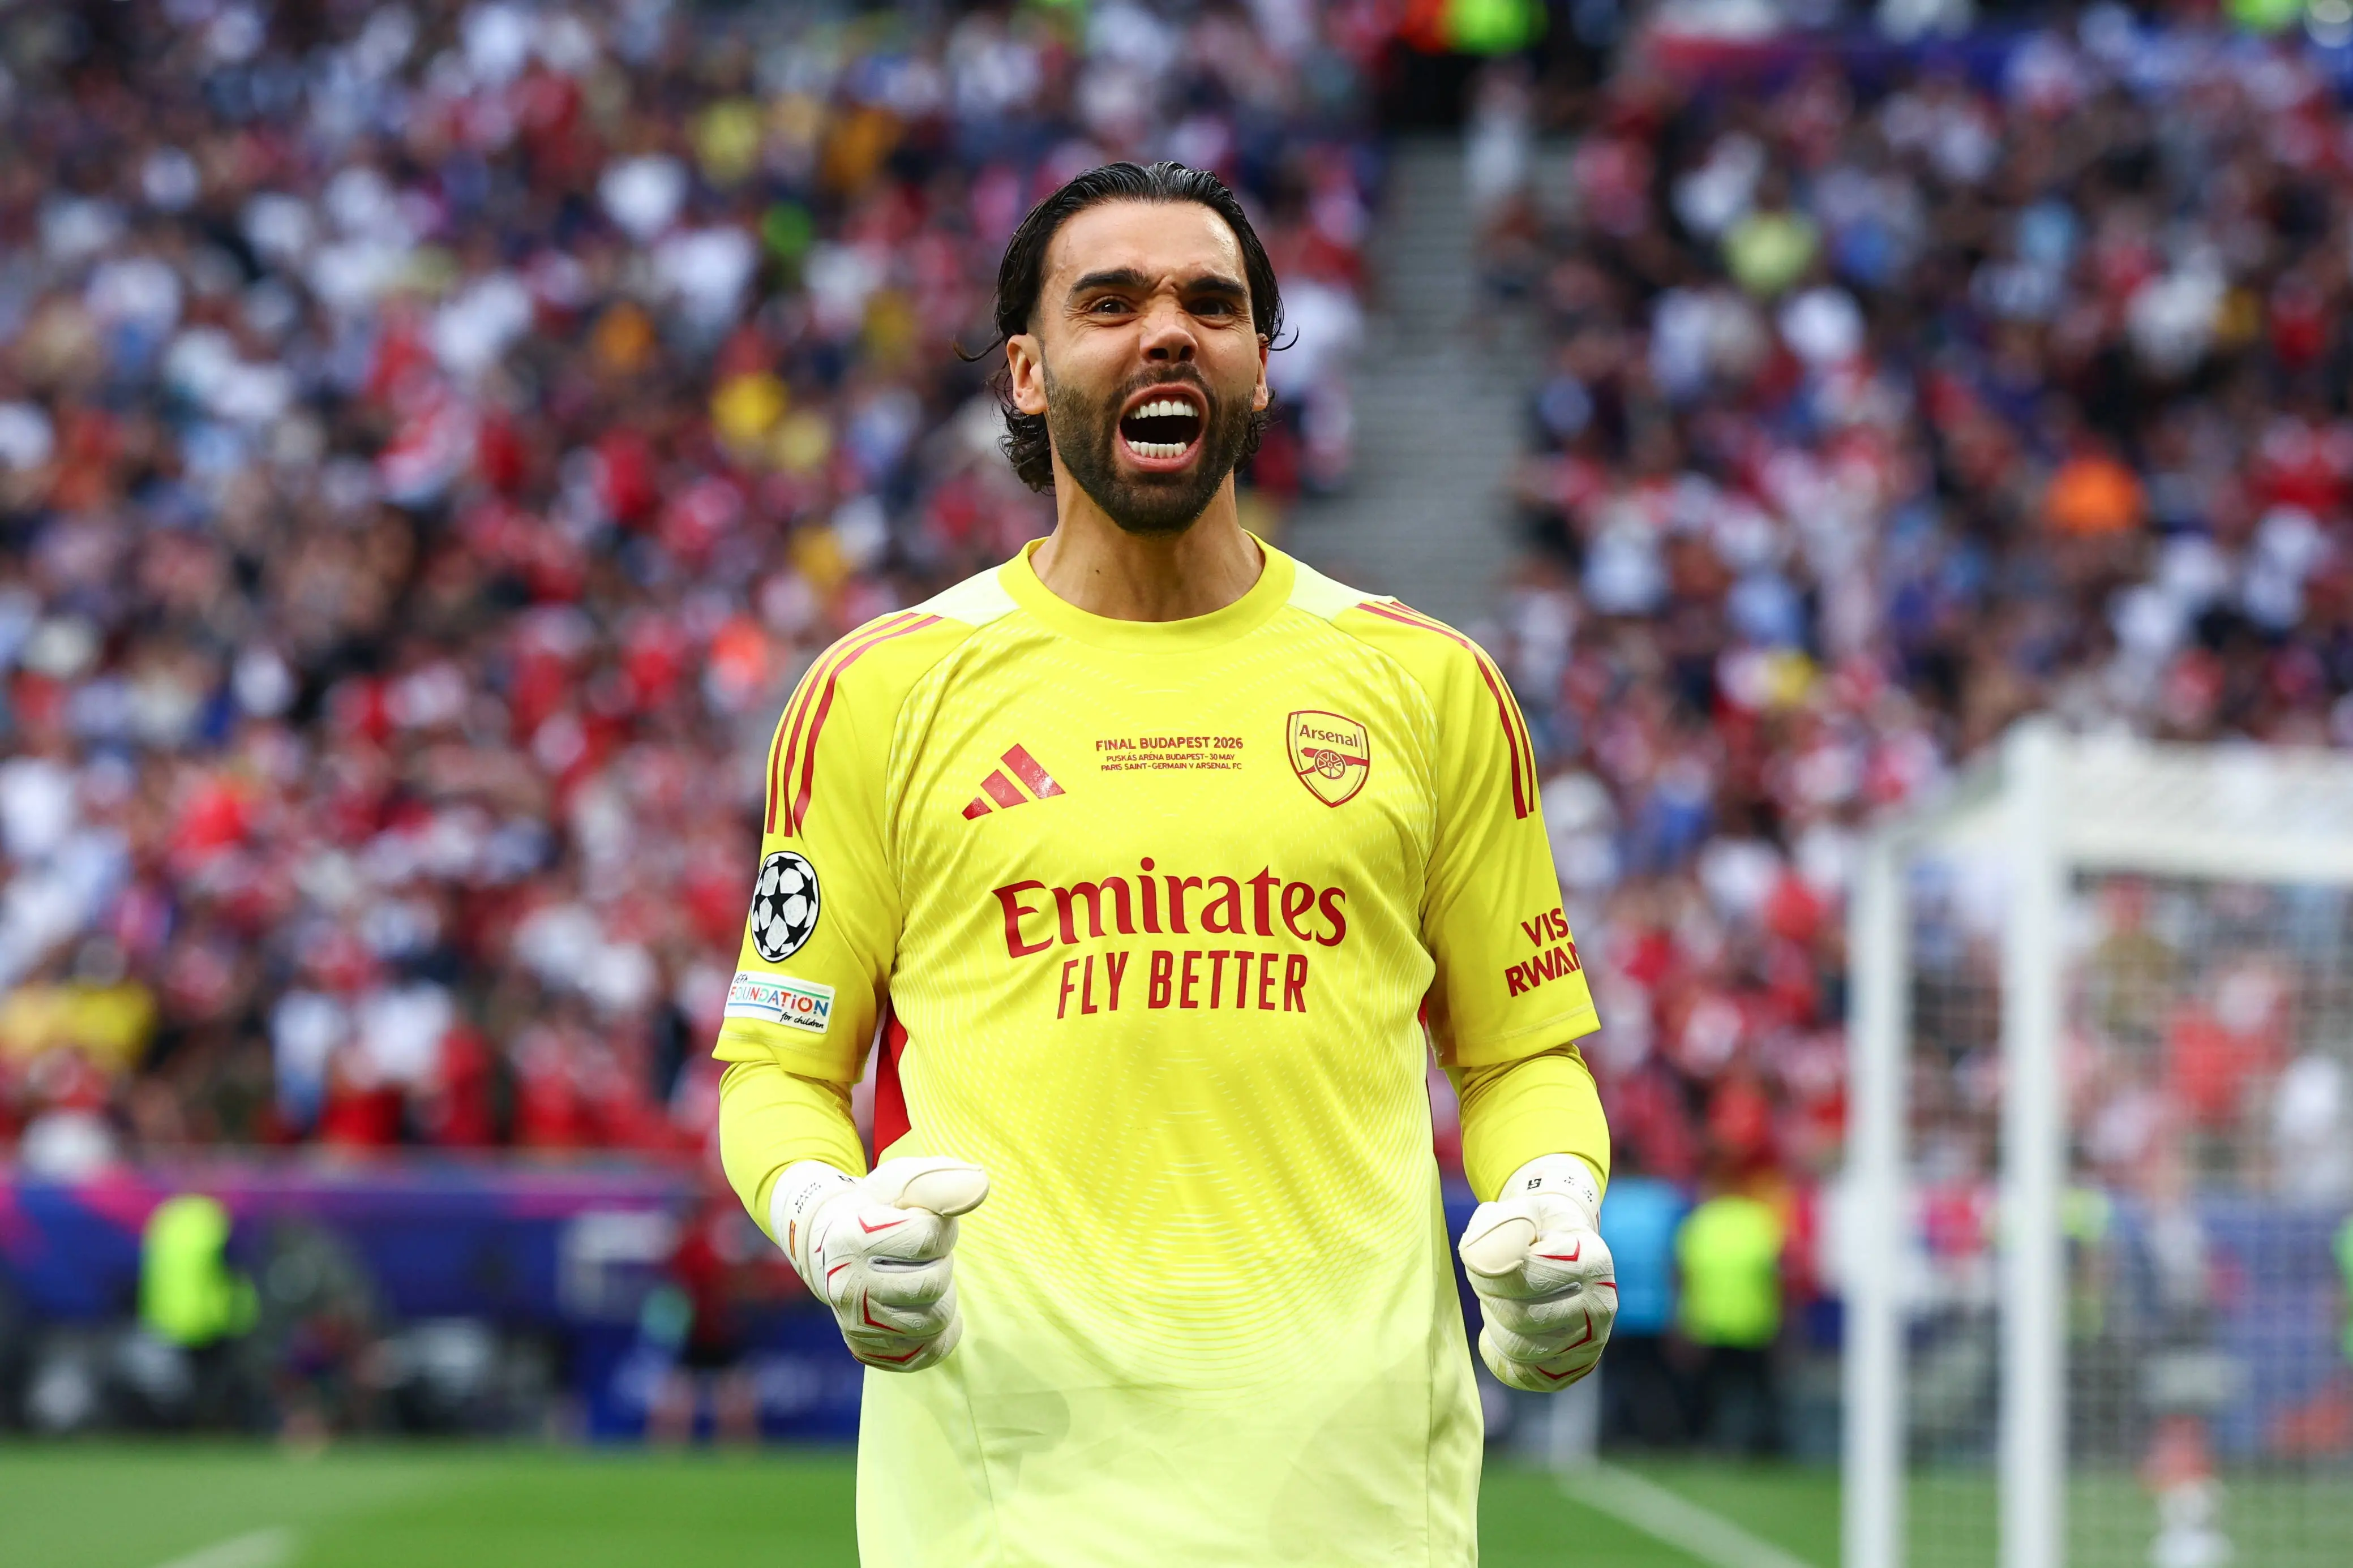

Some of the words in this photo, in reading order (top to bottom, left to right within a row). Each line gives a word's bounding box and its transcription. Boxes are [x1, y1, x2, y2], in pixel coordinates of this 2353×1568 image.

[1096, 738, 1137, 751] FINAL
[1139, 737, 1210, 749] BUDAPEST
[1213, 737, 1244, 749] 2026
[1300, 724, 1358, 748] Arsenal
[1106, 752, 1137, 762] PUSKÁS
[1138, 751, 1164, 760] ARÉNA
[992, 857, 1347, 959] Emirates
[1057, 951, 1129, 1019] FLY
[1147, 950, 1308, 1013] BETTER
[779, 1011, 792, 1022] for
[794, 1016, 824, 1029] children
